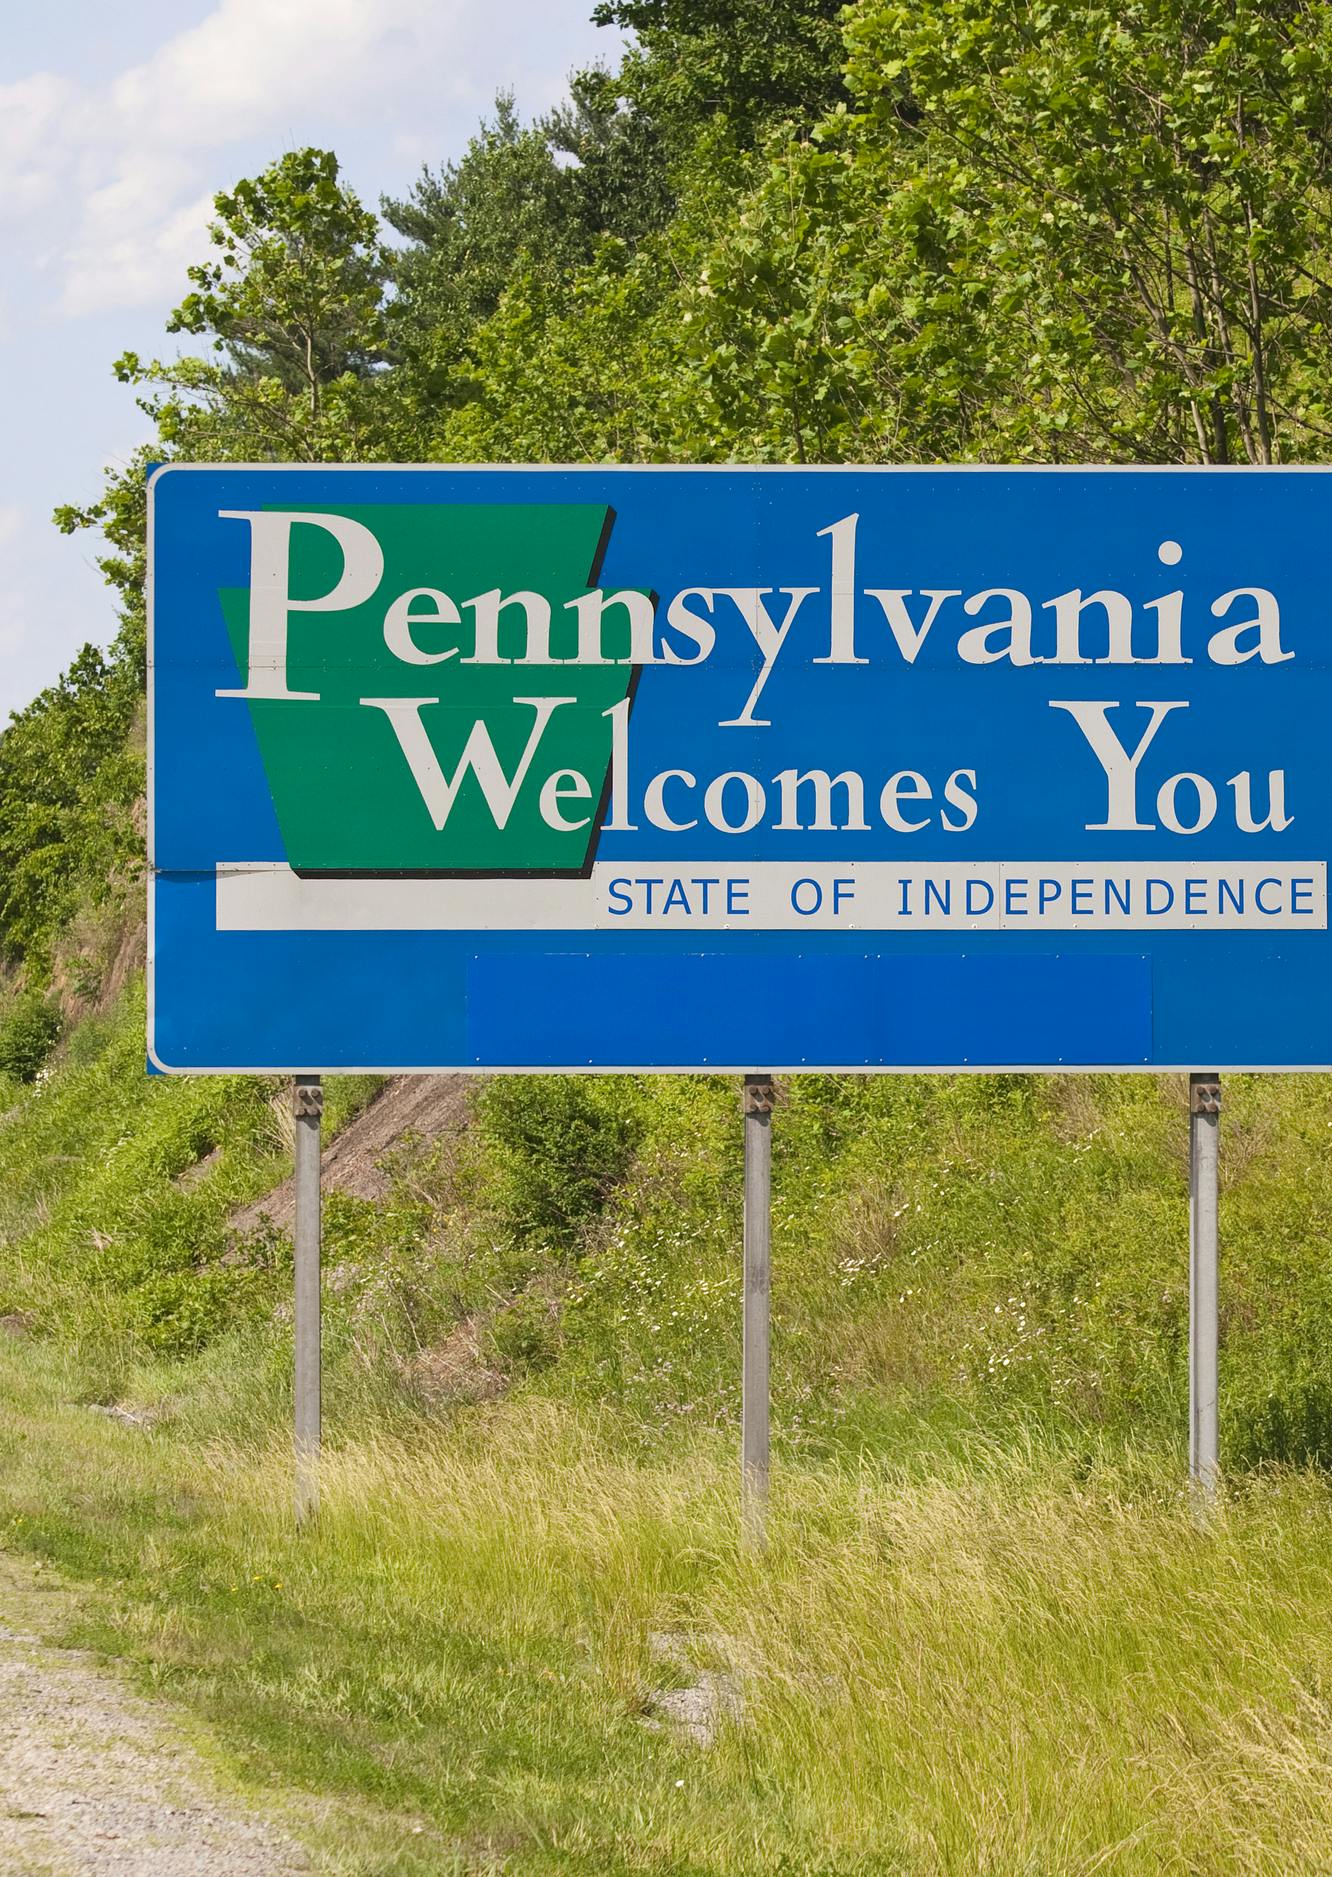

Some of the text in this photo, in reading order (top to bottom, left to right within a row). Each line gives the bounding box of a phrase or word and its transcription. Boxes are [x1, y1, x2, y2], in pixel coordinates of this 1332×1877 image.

[214, 509, 1296, 728] Pennsylvania
[359, 696, 1296, 834] Welcomes You
[607, 877, 1315, 916] STATE OF INDEPENDENCE
